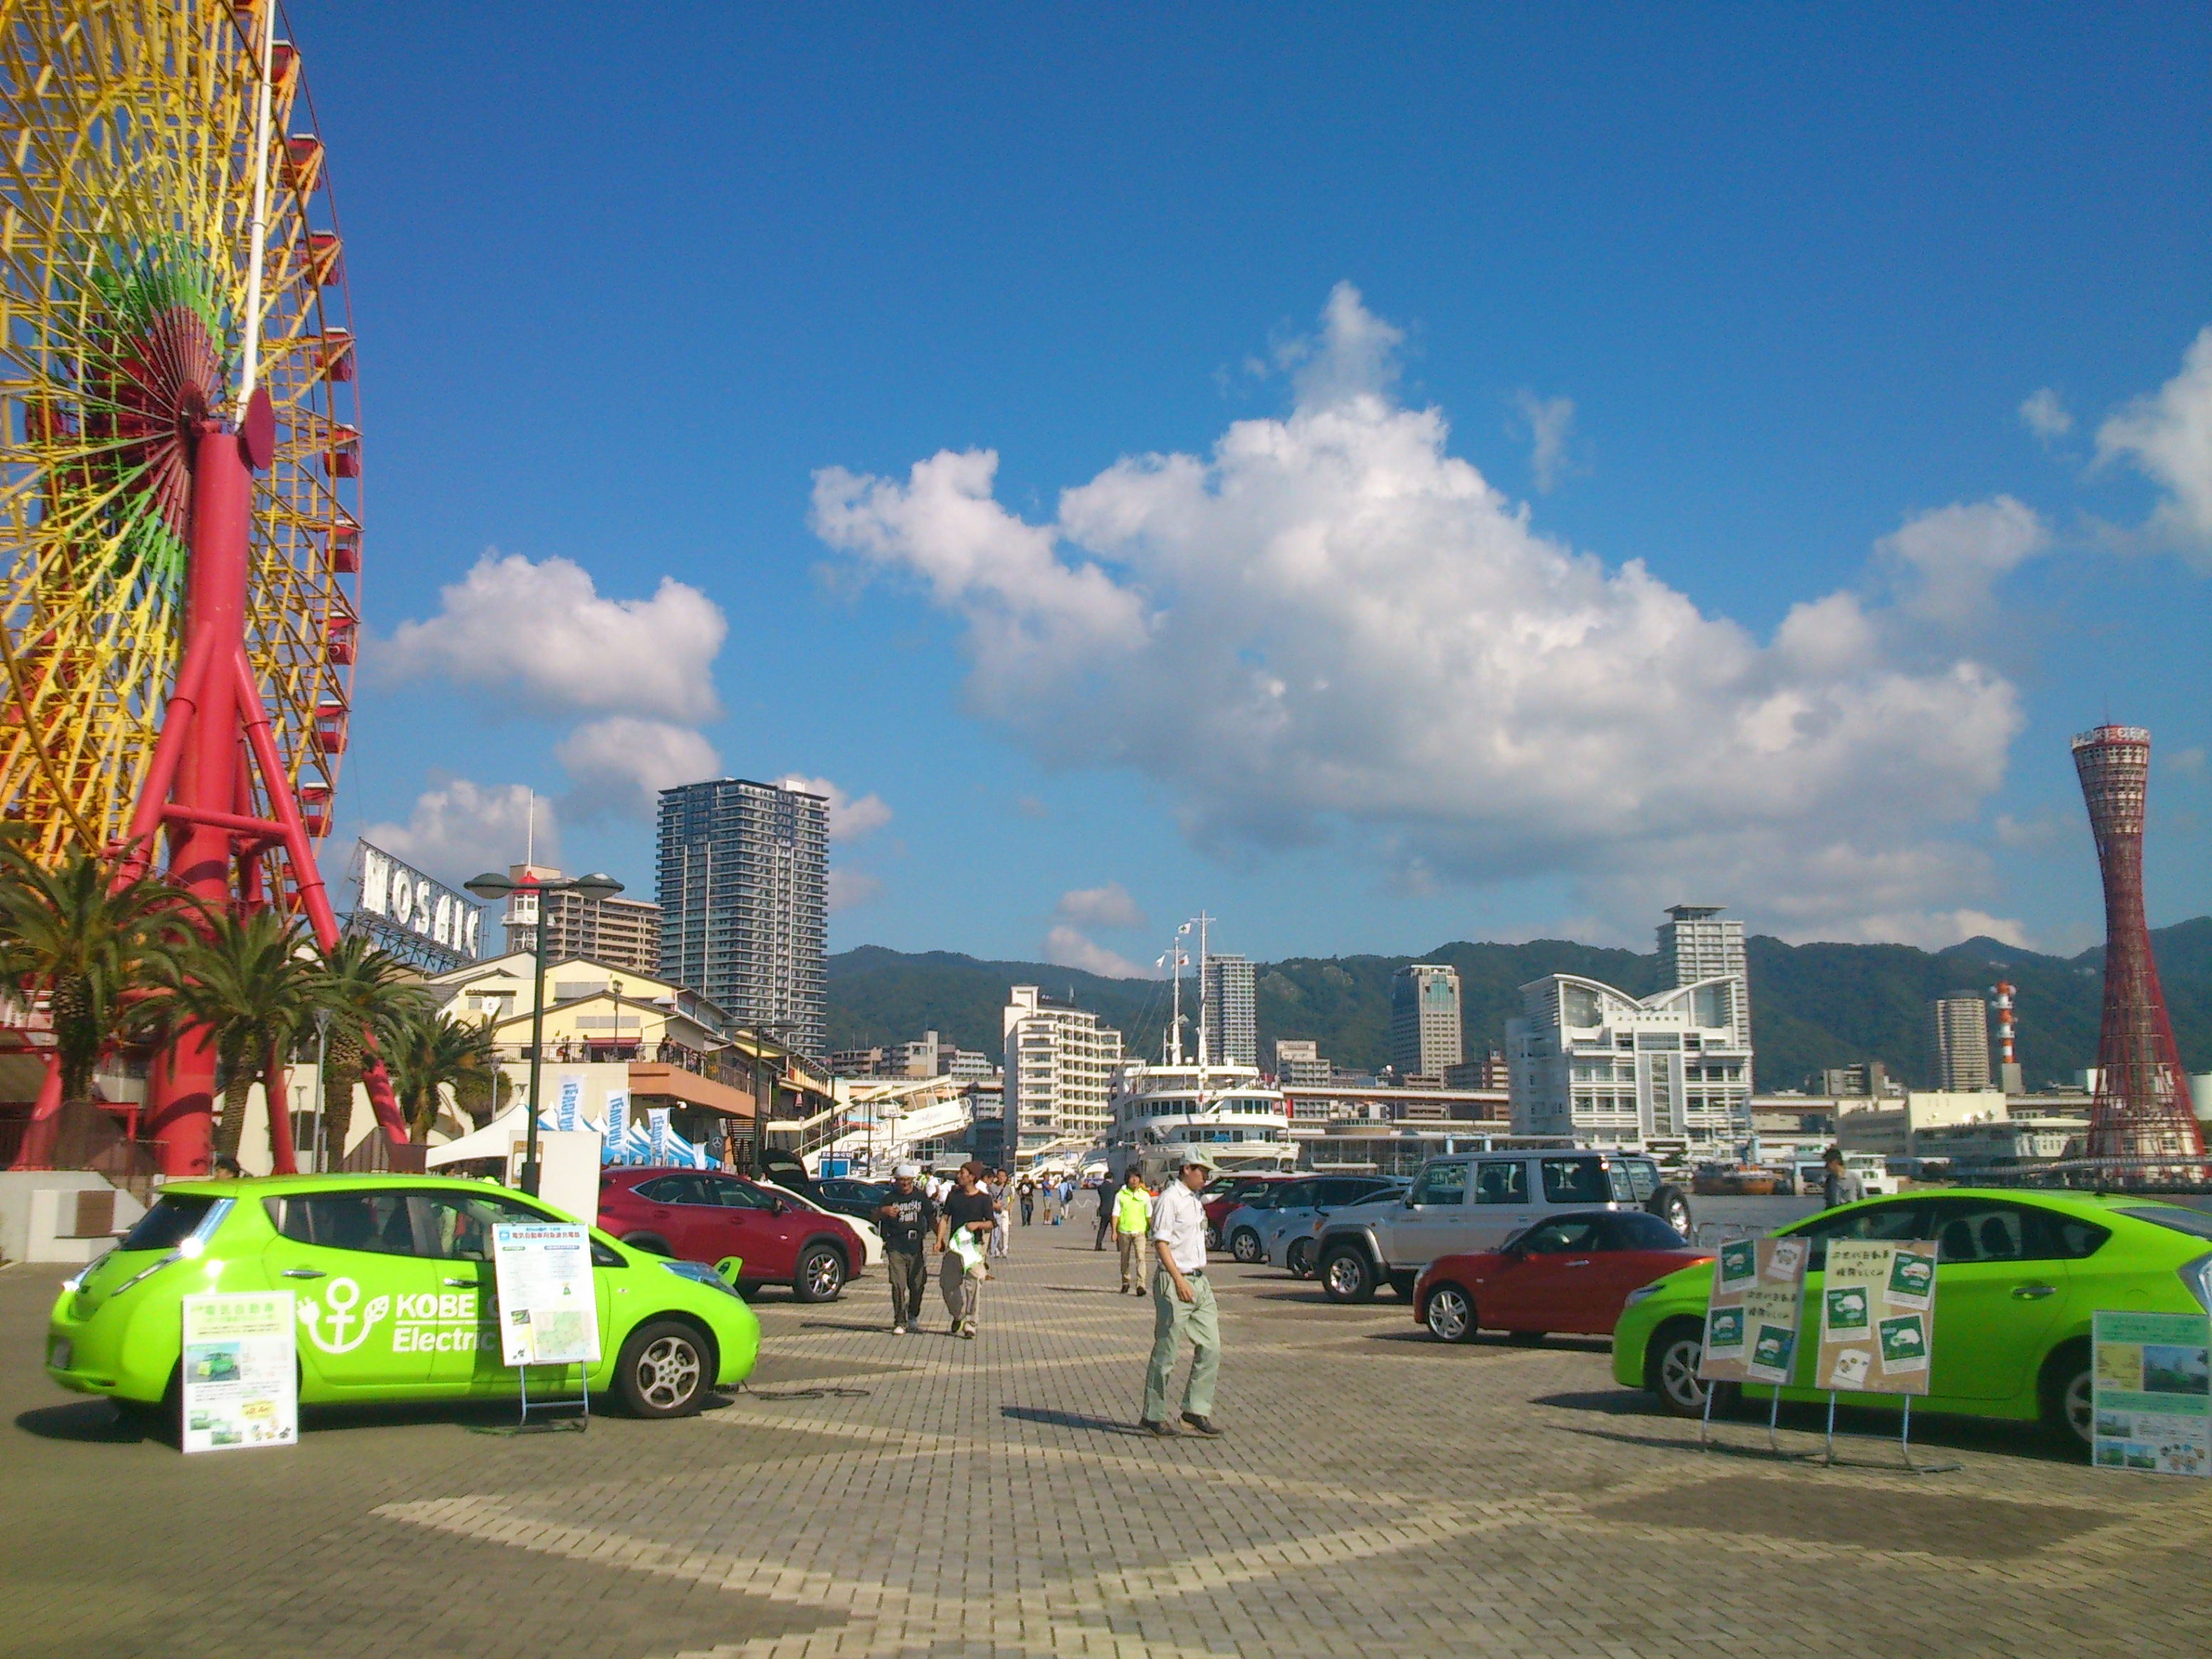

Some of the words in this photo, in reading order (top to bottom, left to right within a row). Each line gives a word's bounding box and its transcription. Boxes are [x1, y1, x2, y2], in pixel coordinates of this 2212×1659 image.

[363, 850, 478, 959] MOSAIC
[396, 1293, 475, 1318] KOBE
[393, 1326, 497, 1352] Electric
